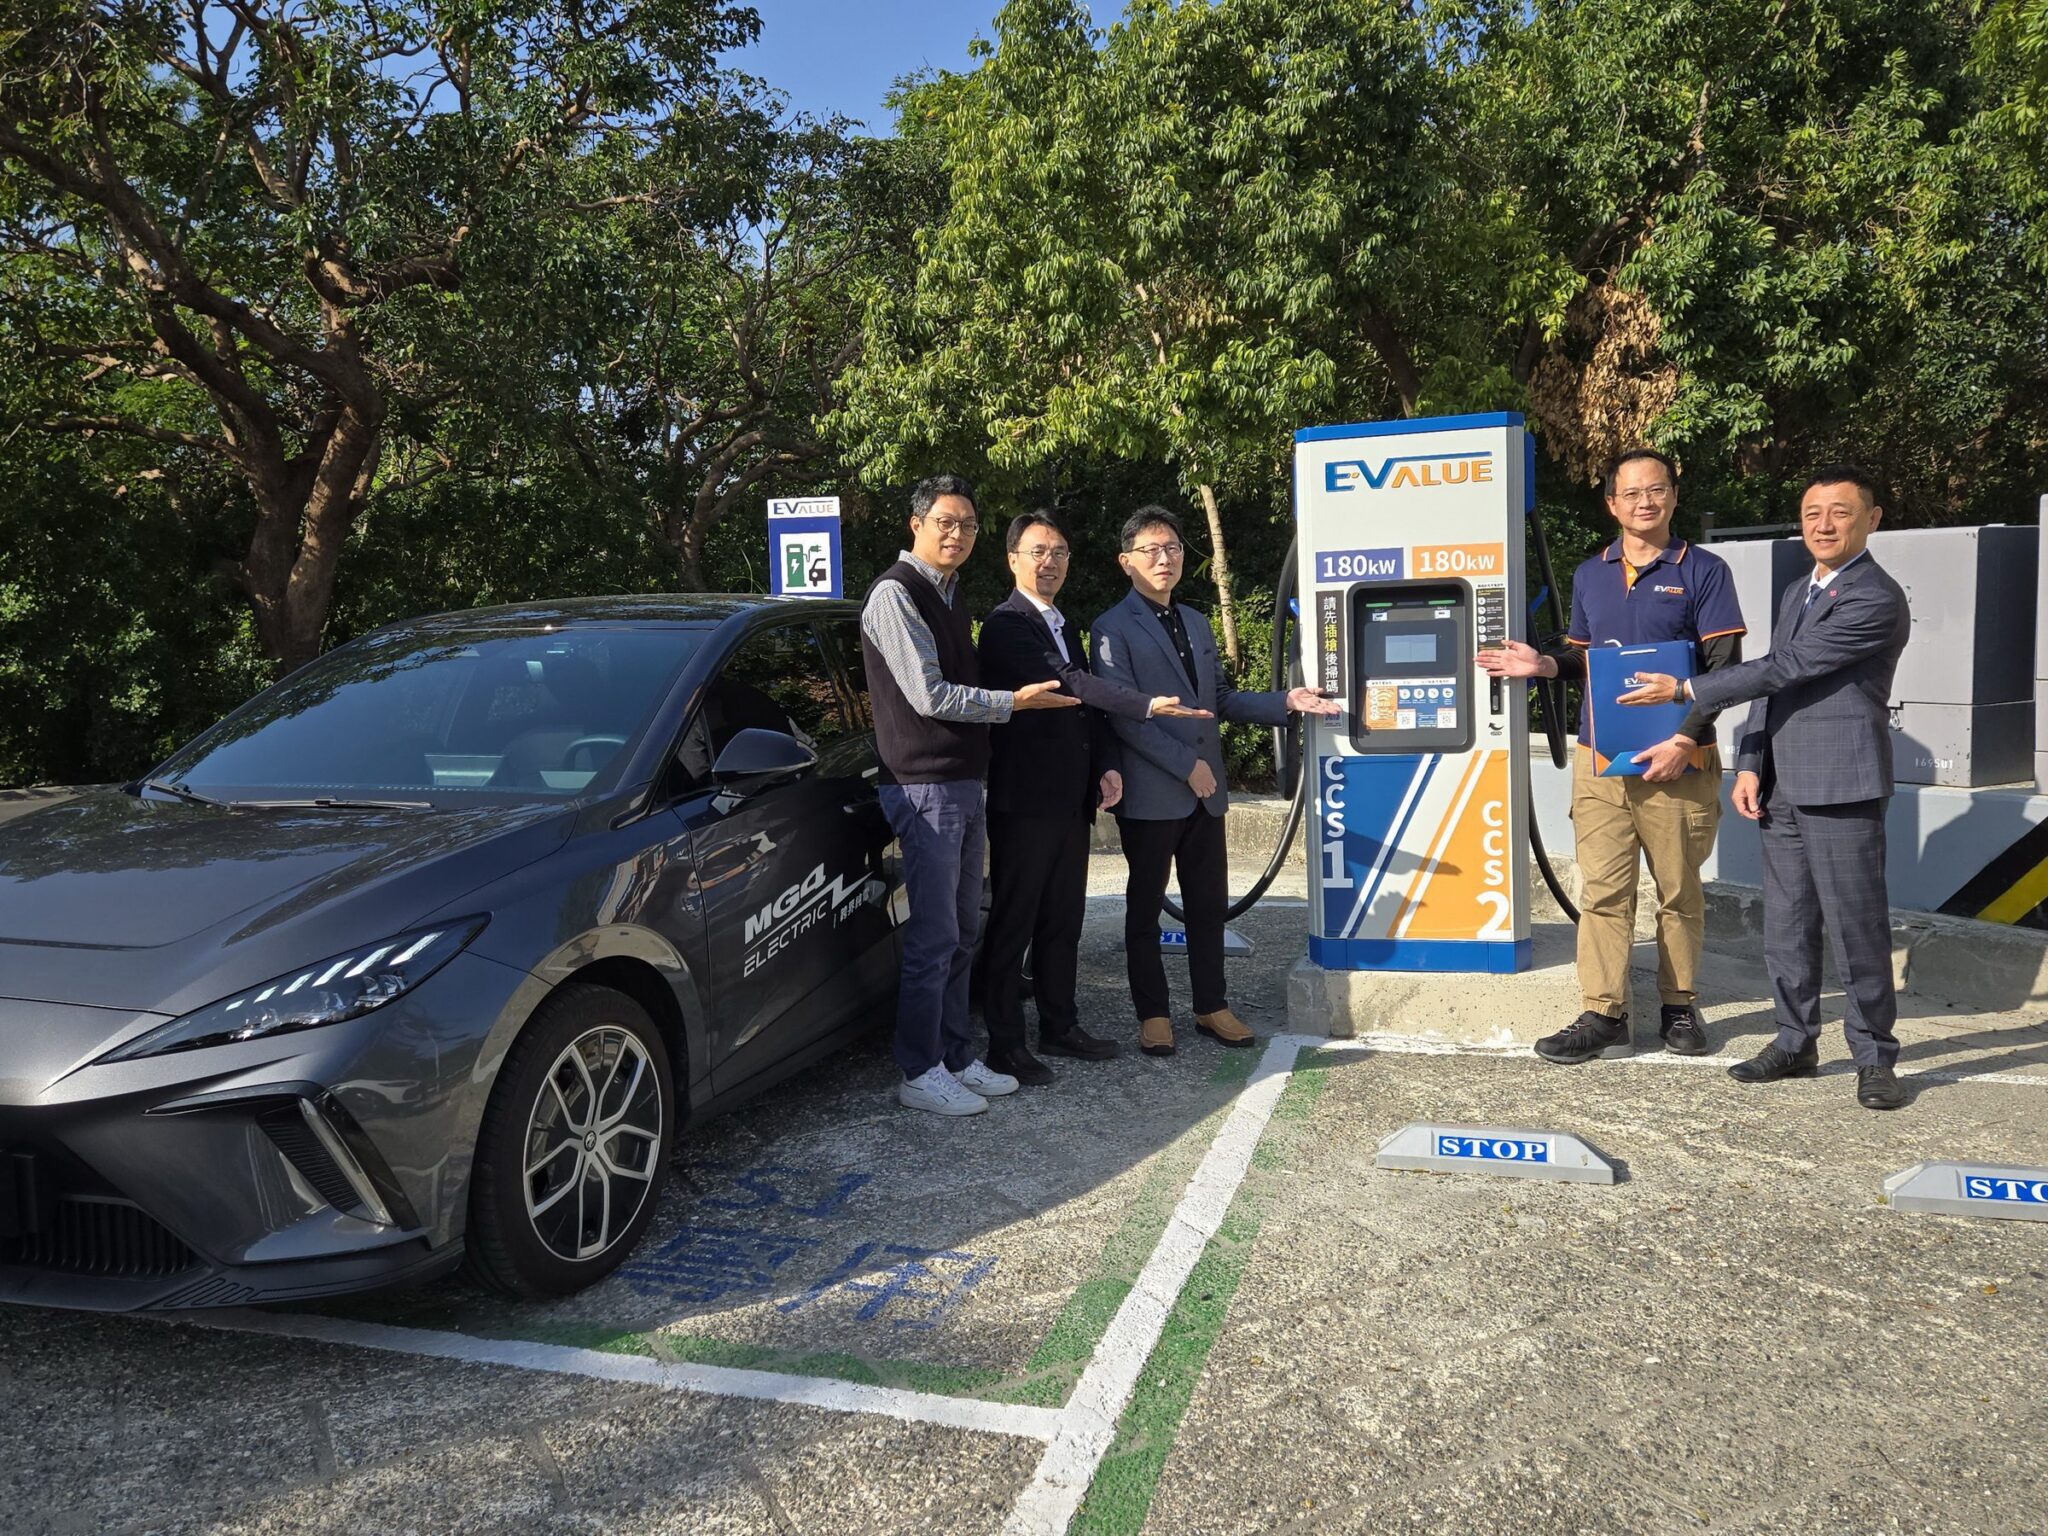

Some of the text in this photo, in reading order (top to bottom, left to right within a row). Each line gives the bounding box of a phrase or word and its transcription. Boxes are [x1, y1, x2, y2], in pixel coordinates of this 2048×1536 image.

[1323, 597, 1339, 694] 請先插槍後掃碼
[1322, 756, 1354, 888] CCS1
[744, 862, 827, 945] MG4
[1475, 800, 1513, 940] CCS2
[743, 900, 828, 978] ELECTRIC
[1441, 1138, 1546, 1160] STOP
